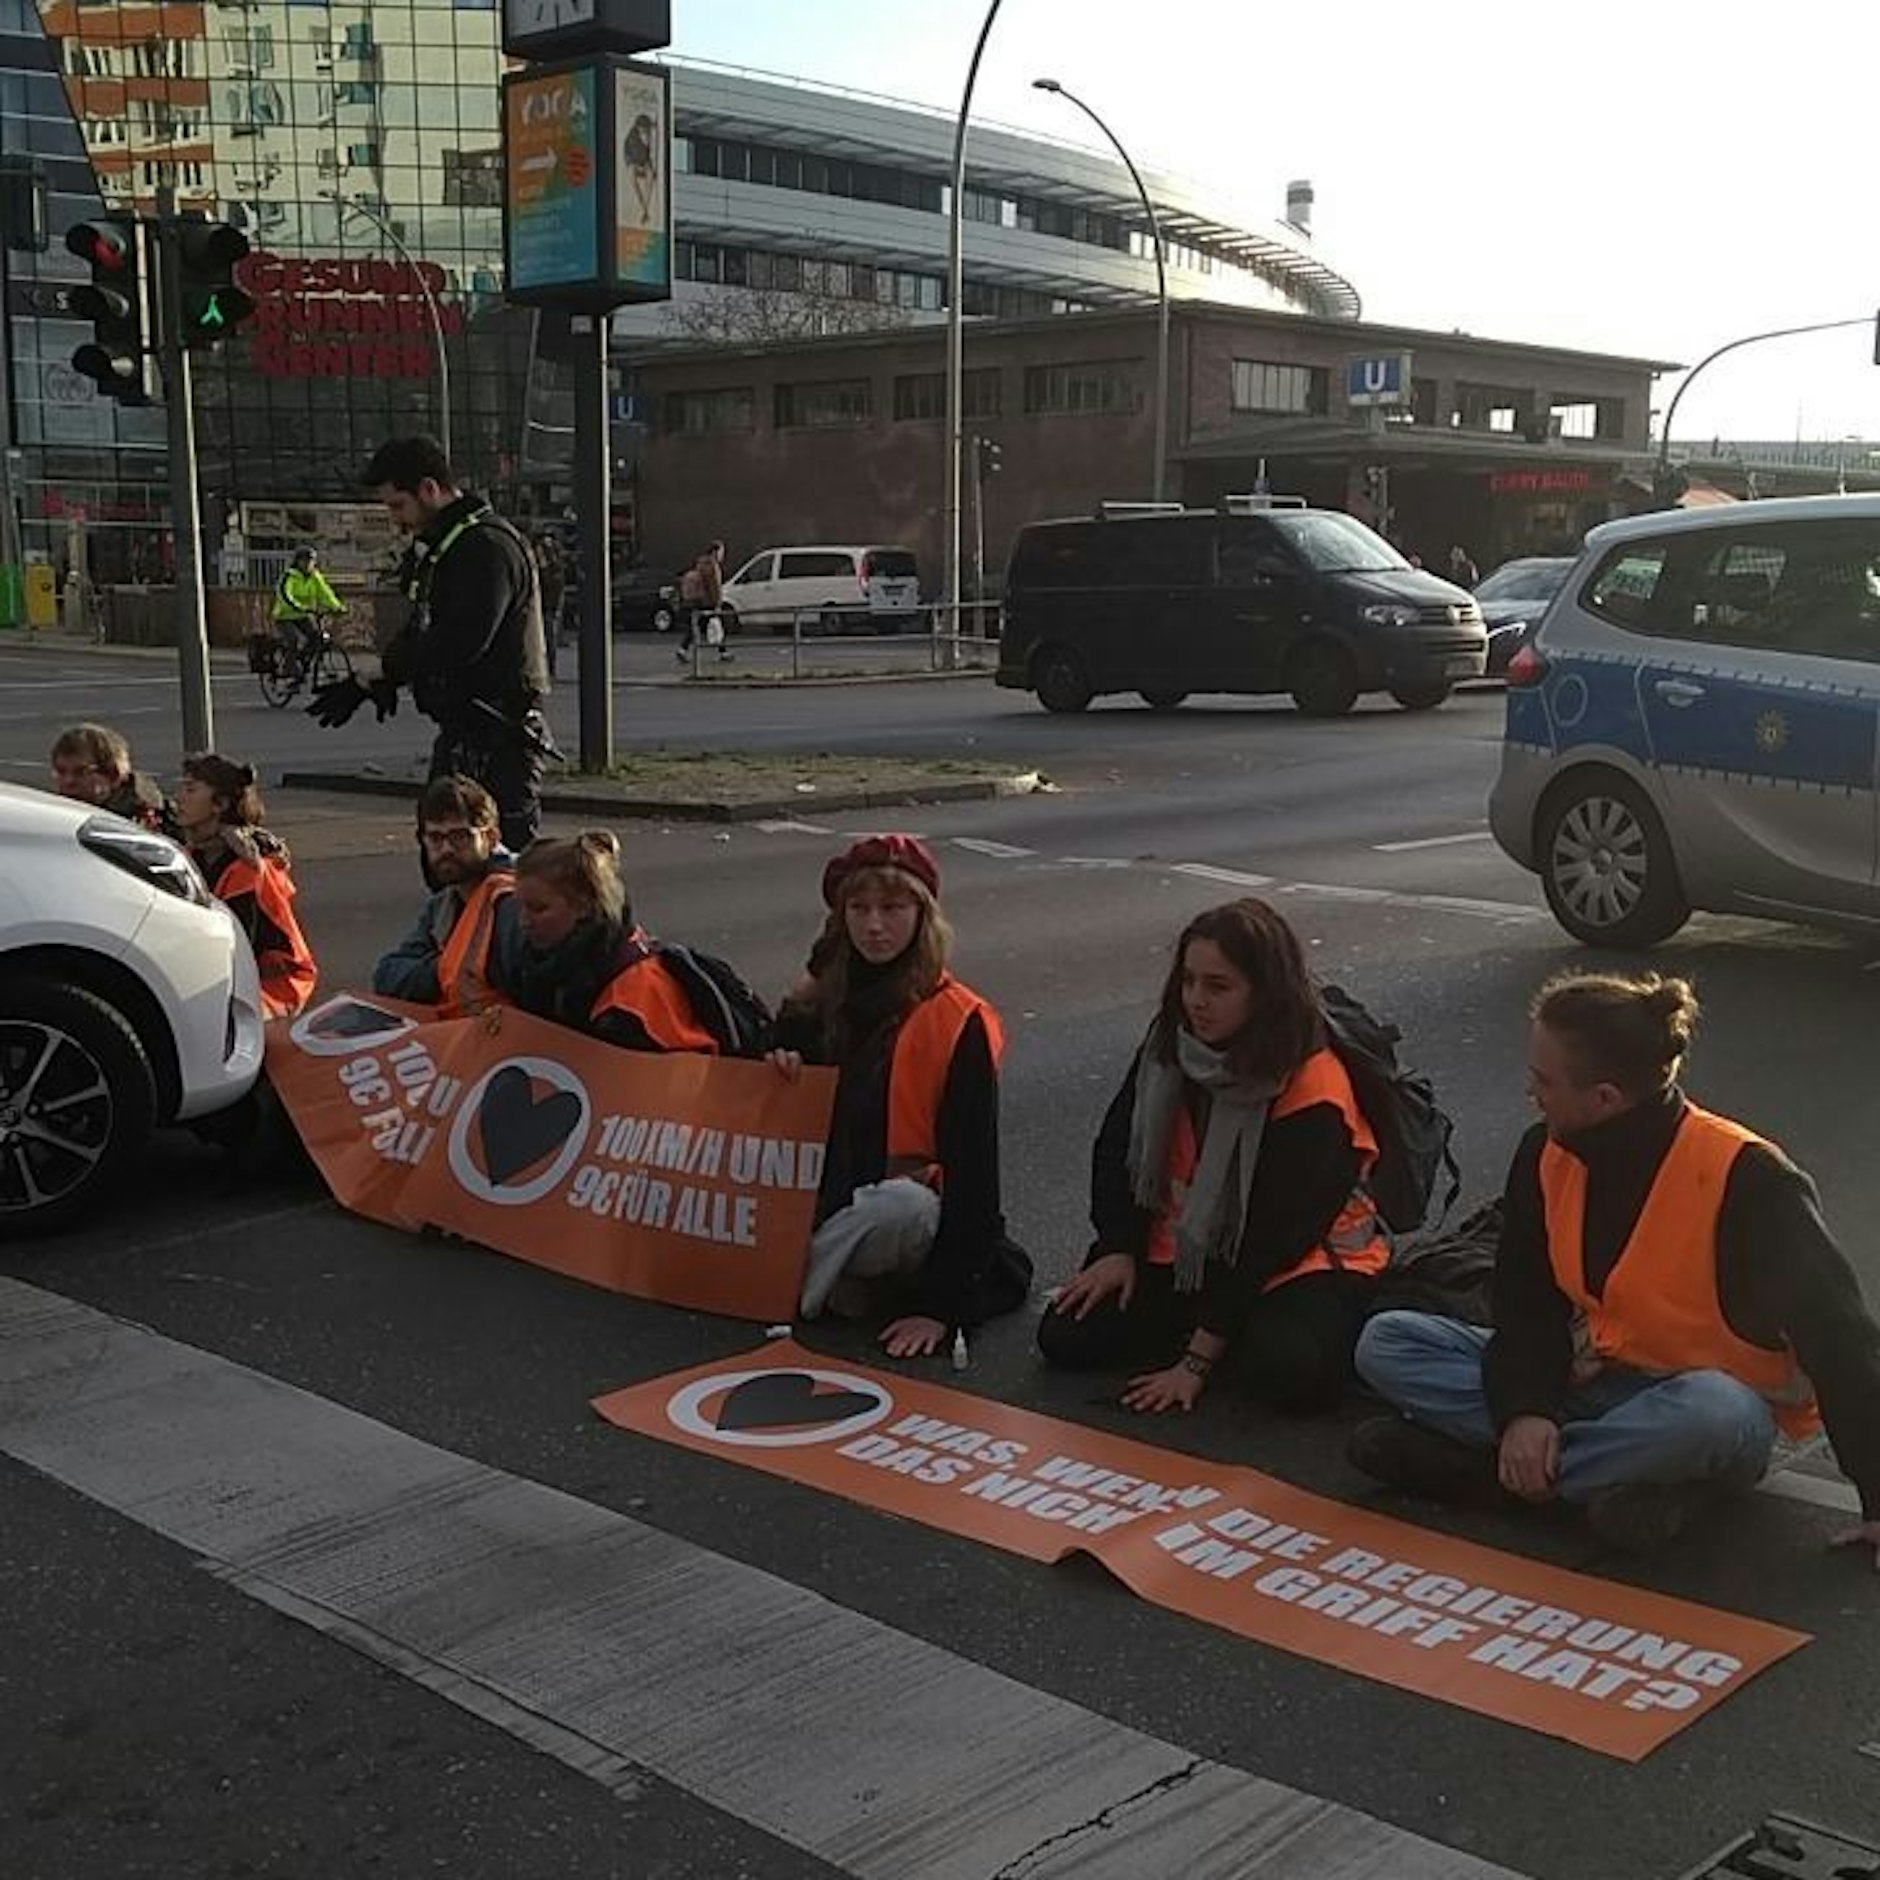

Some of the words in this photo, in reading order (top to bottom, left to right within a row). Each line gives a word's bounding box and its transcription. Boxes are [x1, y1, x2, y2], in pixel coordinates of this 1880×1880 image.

[232, 249, 446, 296] GESUND
[240, 298, 464, 335] RUNNEN
[1364, 360, 1386, 391] U
[617, 396, 634, 421] U
[730, 1134, 827, 1190] UND
[672, 1185, 759, 1247] ALLE
[834, 1433, 975, 1485] DAS
[959, 1471, 1172, 1535] NICH
[1153, 1521, 1264, 1580] IM
[1253, 1567, 1482, 1649] GRIFF
[1465, 1633, 1701, 1712] HAT?
[887, 1413, 1029, 1471] WAS,
[1207, 1508, 1332, 1560] DIE
[1318, 1547, 1744, 1687] REGIERUNG
